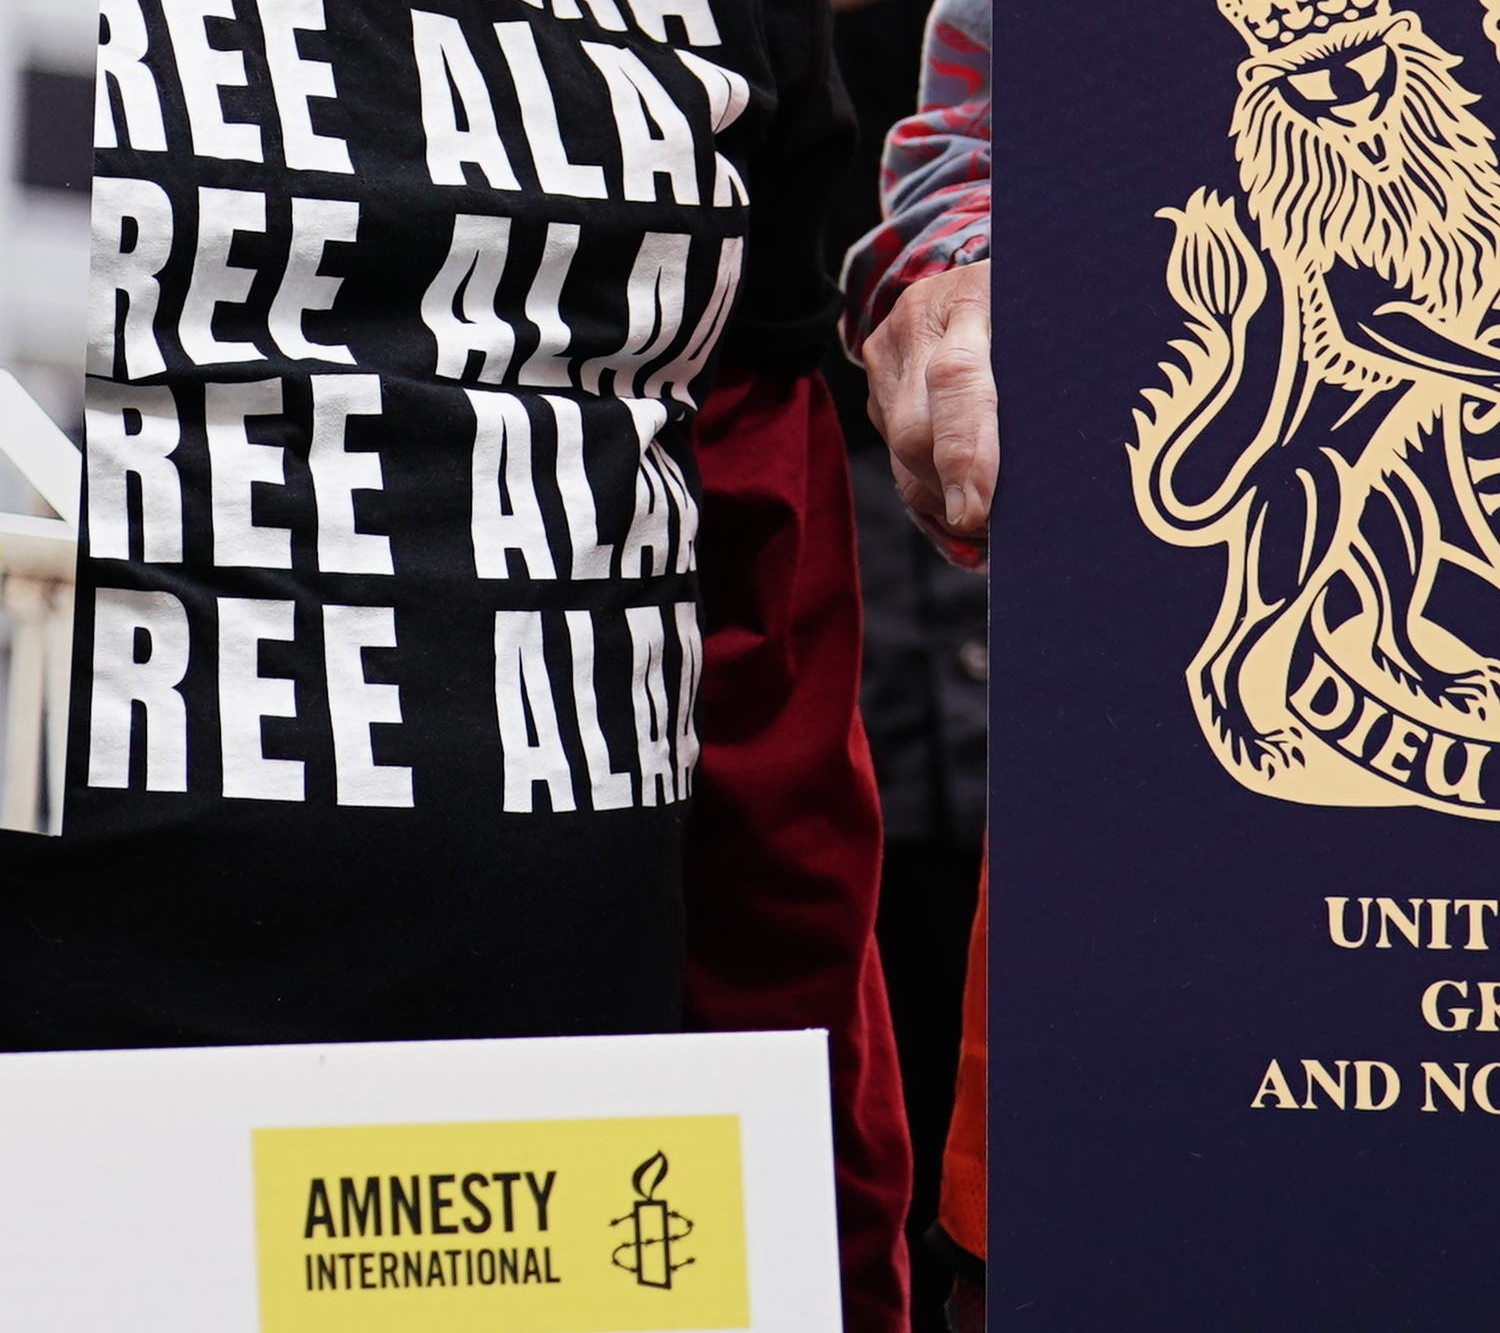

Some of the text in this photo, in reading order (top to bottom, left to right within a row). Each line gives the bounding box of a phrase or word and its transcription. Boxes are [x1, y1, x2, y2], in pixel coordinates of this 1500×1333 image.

[87, 176, 744, 411] REE ALAA
[85, 374, 395, 575] REE
[87, 587, 702, 814] REE ALAA
[1290, 664, 1487, 804] DIEU
[1250, 1059, 1400, 1114] AND
[303, 1170, 557, 1239] AMNESTY
[305, 1246, 561, 1292] INTERNATIONAL
